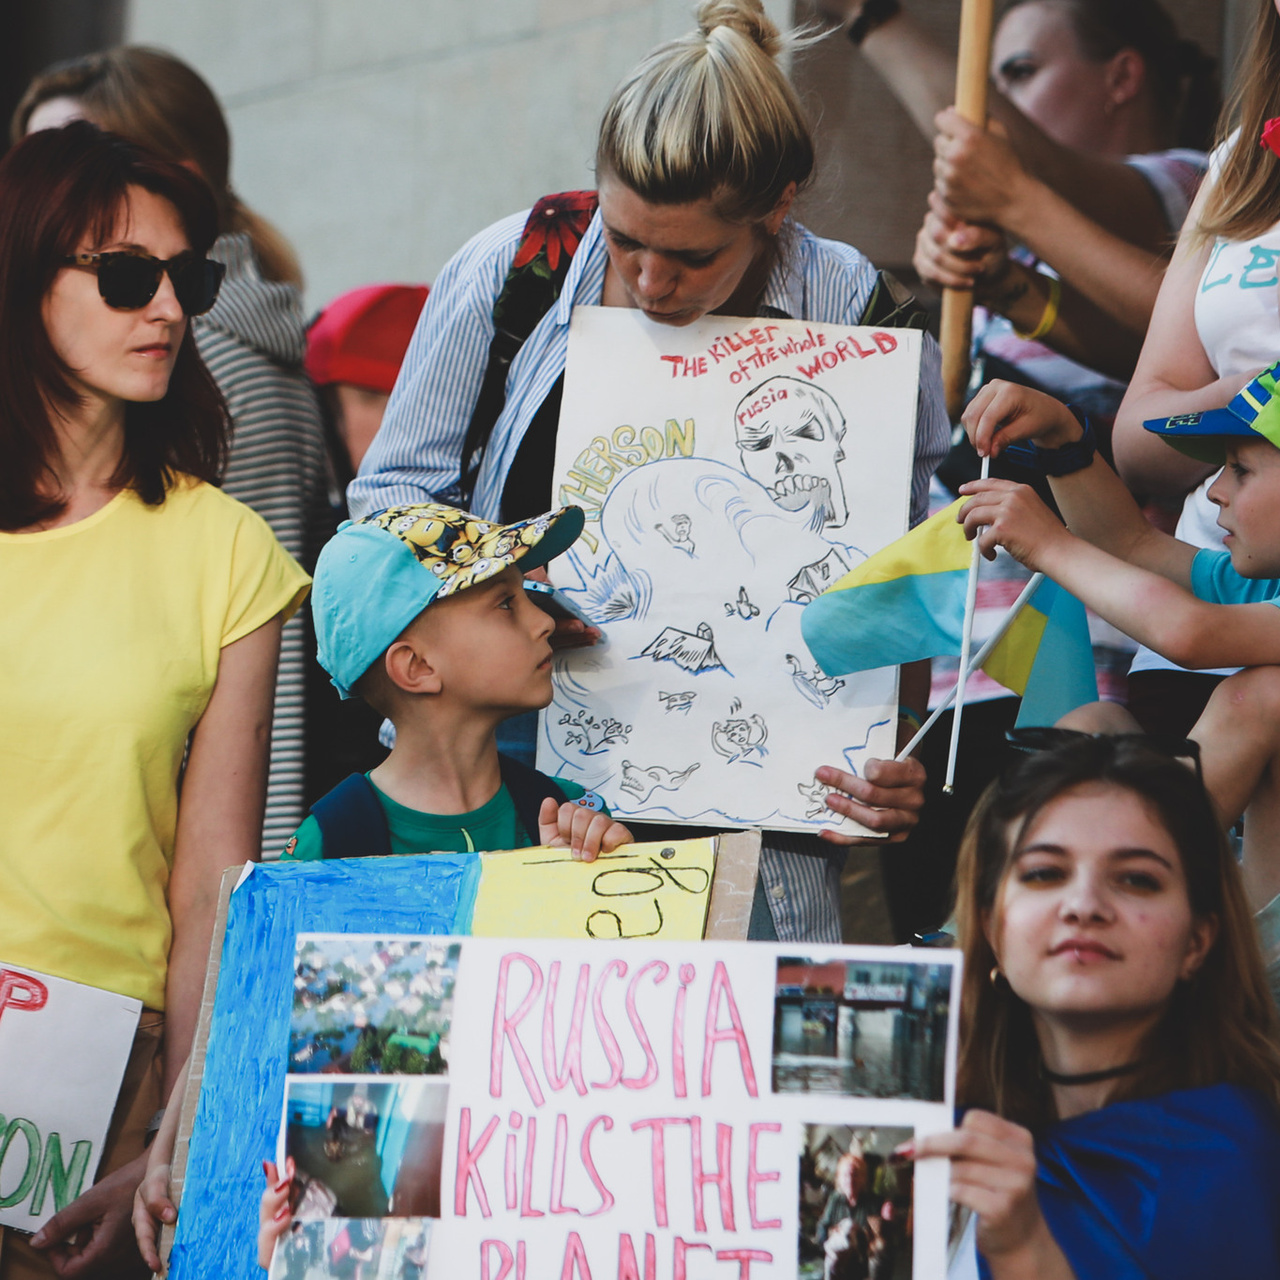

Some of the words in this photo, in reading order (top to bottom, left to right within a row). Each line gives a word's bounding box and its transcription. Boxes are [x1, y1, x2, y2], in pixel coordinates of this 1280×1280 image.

[660, 354, 709, 379] THE
[730, 360, 752, 385] of
[796, 331, 898, 380] WORLD
[736, 388, 789, 426] russia
[630, 1114, 783, 1234] THE
